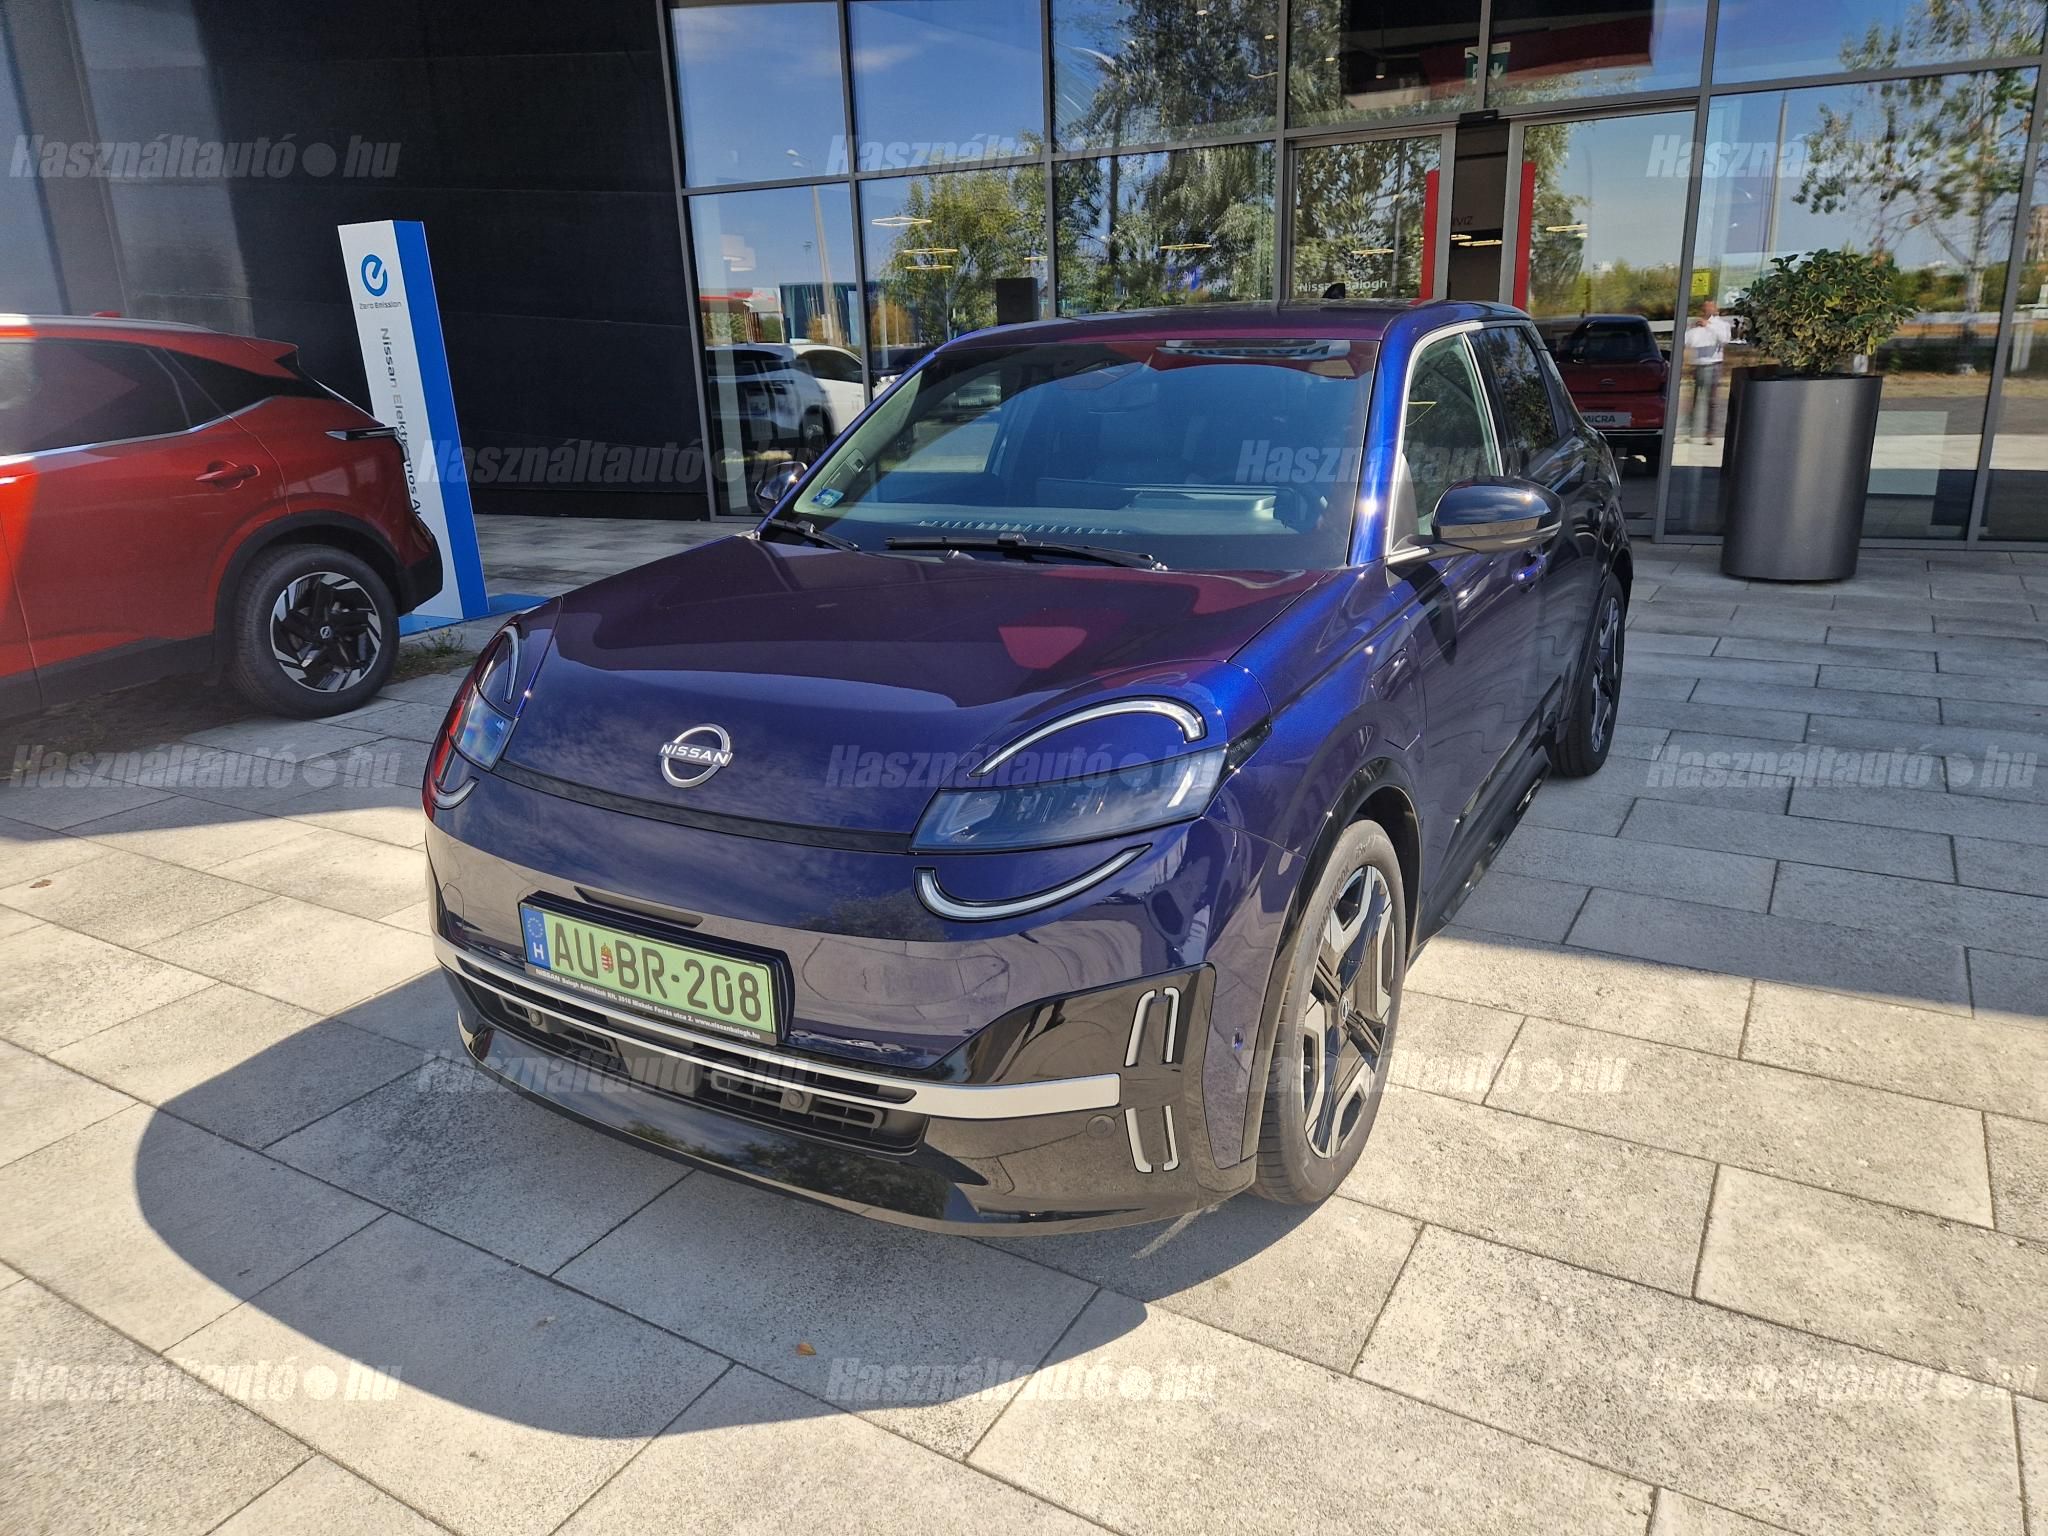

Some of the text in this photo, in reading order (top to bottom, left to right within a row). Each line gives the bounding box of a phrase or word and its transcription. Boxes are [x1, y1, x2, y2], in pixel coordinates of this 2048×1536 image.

[1300, 278, 1388, 295] Nissa Balogh
[380, 327, 398, 389] Nissan
[660, 743, 729, 765] NISSAN
[532, 941, 545, 960] H
[554, 922, 599, 979] AU
